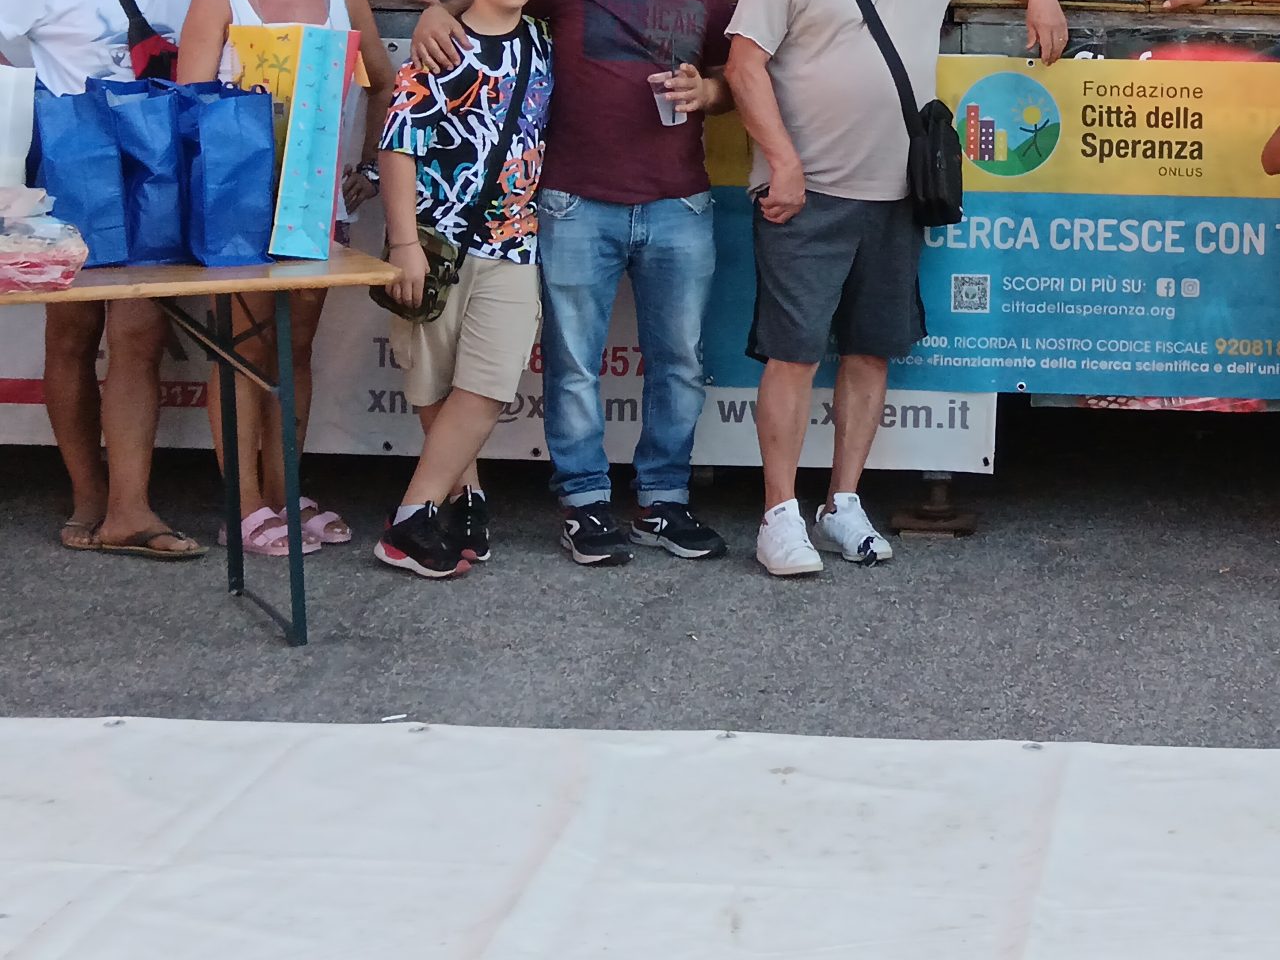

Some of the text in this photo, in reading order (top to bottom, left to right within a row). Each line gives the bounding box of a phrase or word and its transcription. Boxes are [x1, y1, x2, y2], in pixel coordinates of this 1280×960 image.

[1082, 80, 1204, 99] Fondazione
[1081, 104, 1203, 129] Città della
[1081, 132, 1203, 163] Speranza
[1158, 166, 1203, 178] ONLUS
[923, 216, 1040, 250] CERCA
[1049, 218, 1185, 253] CRESCE
[1195, 223, 1265, 255] CON
[1002, 274, 1147, 294] SCOPRI DI PIÙ SU:
[1001, 300, 1176, 320] cittadellasperanza.org
[954, 336, 1017, 350] RICORDA
[1021, 338, 1031, 350] IL
[1035, 338, 1092, 351] NOSTRO
[1096, 339, 1150, 353] CODICE
[1155, 341, 1208, 354] FISCALE
[1040, 355, 1076, 369] della
[1081, 357, 1131, 371] ricerca
[1135, 359, 1209, 374] scientifica
[1213, 362, 1222, 373] e
